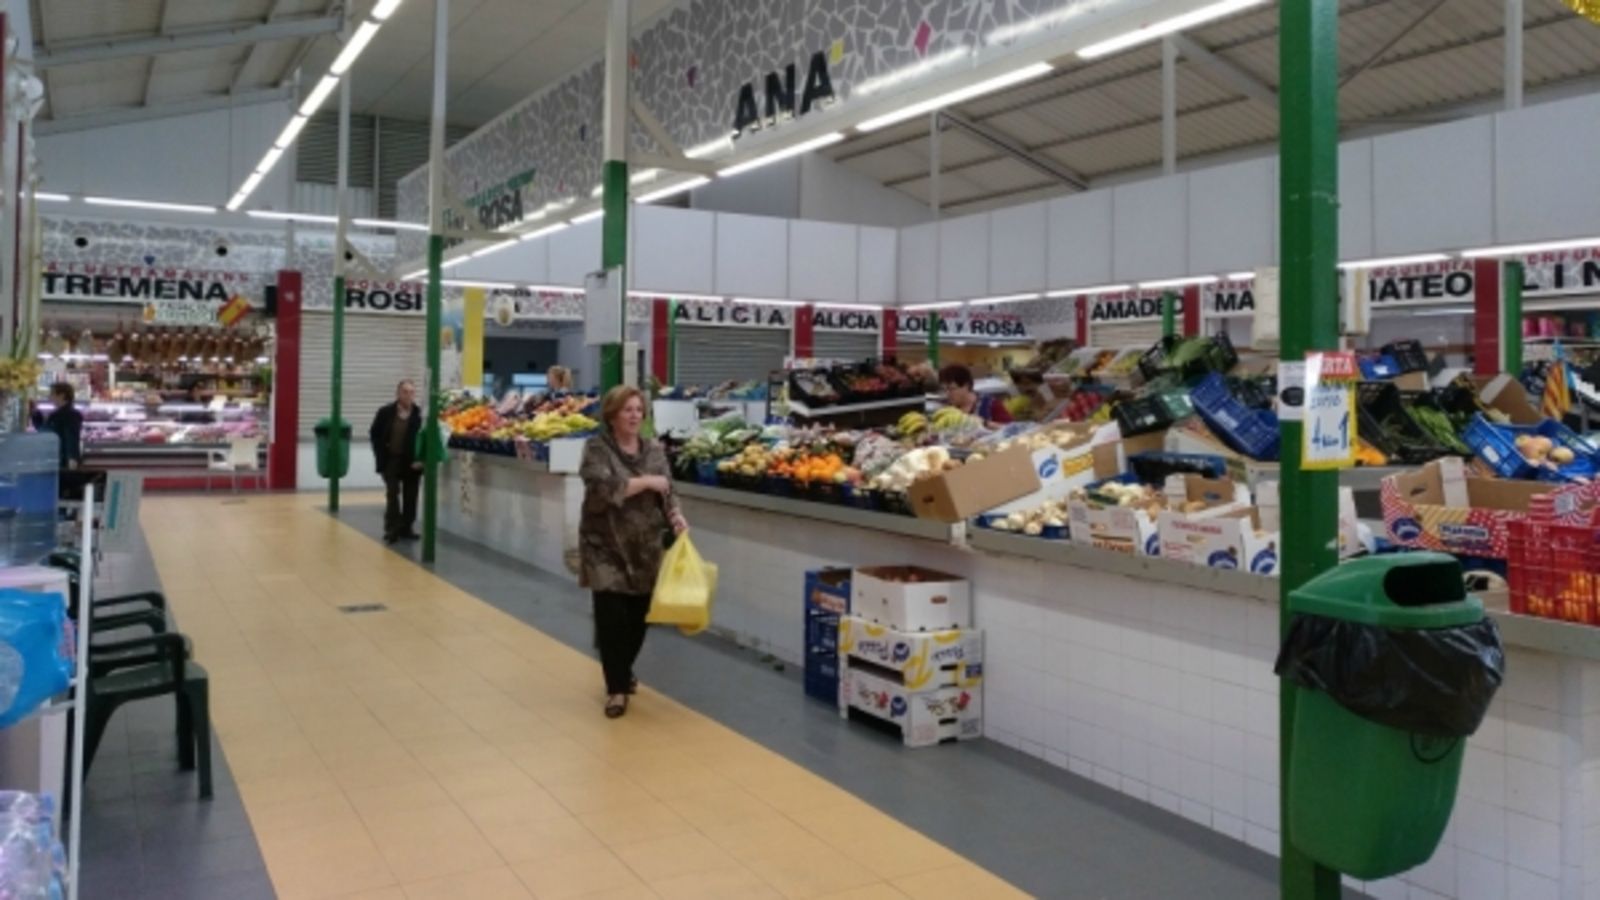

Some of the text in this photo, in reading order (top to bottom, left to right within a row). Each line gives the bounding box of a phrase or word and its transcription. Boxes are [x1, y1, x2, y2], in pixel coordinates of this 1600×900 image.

[733, 50, 835, 131] ANA
[346, 288, 423, 311] ROSI
[1091, 294, 1185, 321] AMADEO
[674, 303, 785, 326] ALICIA
[812, 312, 879, 330] ALICIA
[895, 313, 948, 332] LOLA
[970, 319, 1027, 337] ROSA
